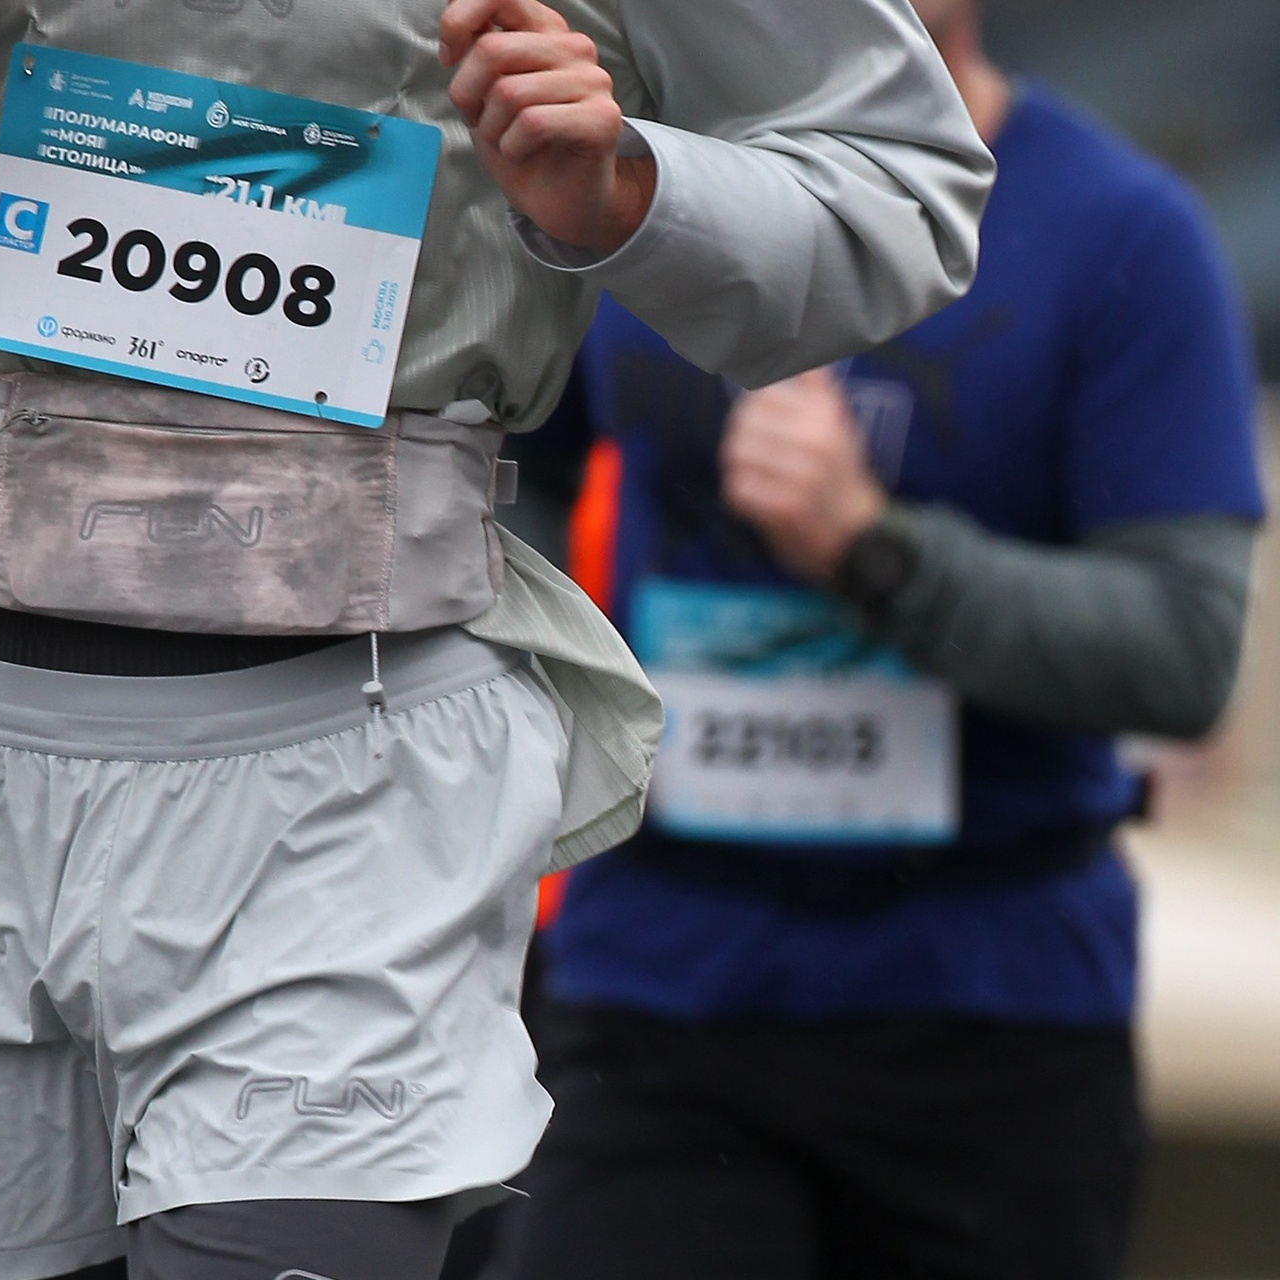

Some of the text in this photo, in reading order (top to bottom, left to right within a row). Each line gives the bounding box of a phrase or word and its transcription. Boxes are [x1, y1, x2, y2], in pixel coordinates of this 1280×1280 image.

[48, 107, 197, 149] ПОЛУМАРАФОН
[57, 218, 336, 327] 20908
[372, 280, 388, 328] МОСКВА
